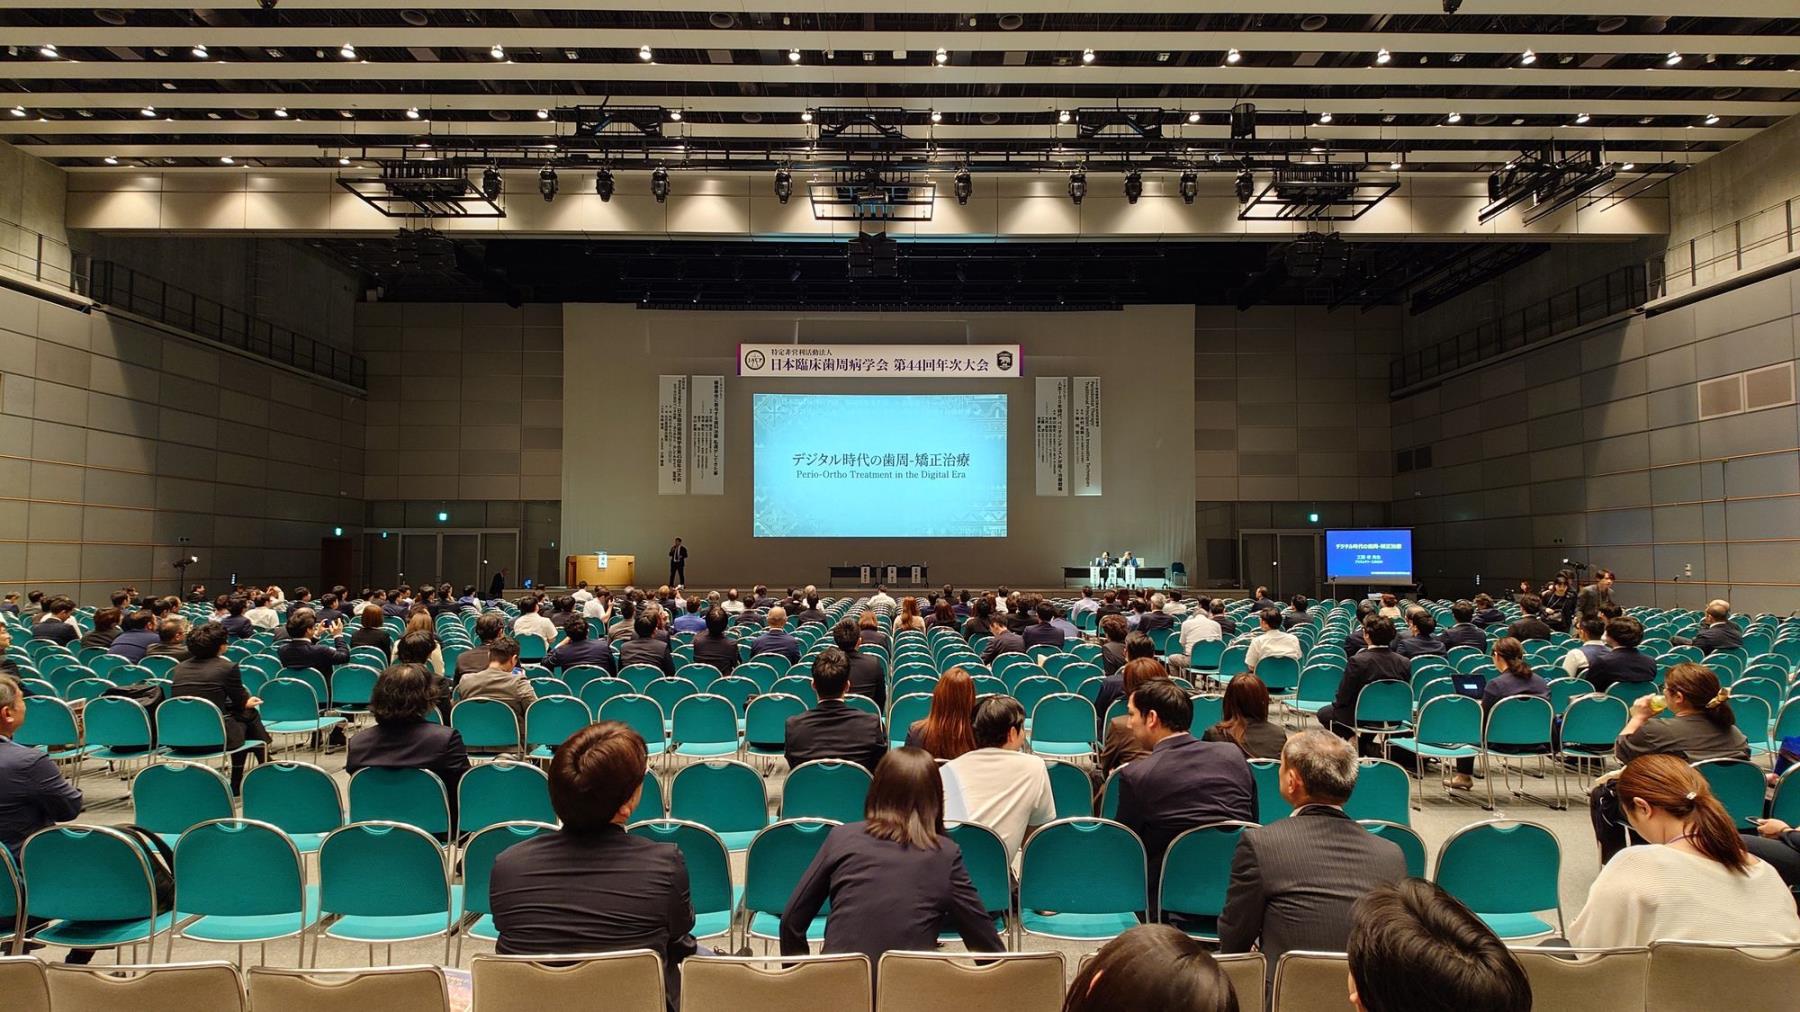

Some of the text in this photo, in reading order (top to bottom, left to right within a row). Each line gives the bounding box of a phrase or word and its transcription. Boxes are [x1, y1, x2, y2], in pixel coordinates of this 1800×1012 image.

[771, 358, 889, 371] 日本臨床歯周病学会
[894, 358, 989, 371] 第44回年次大会
[792, 453, 970, 467] デジタル時代の歯周-矯正治療
[796, 470, 966, 480] Perio-Ortho Treatment in the Digital Era
